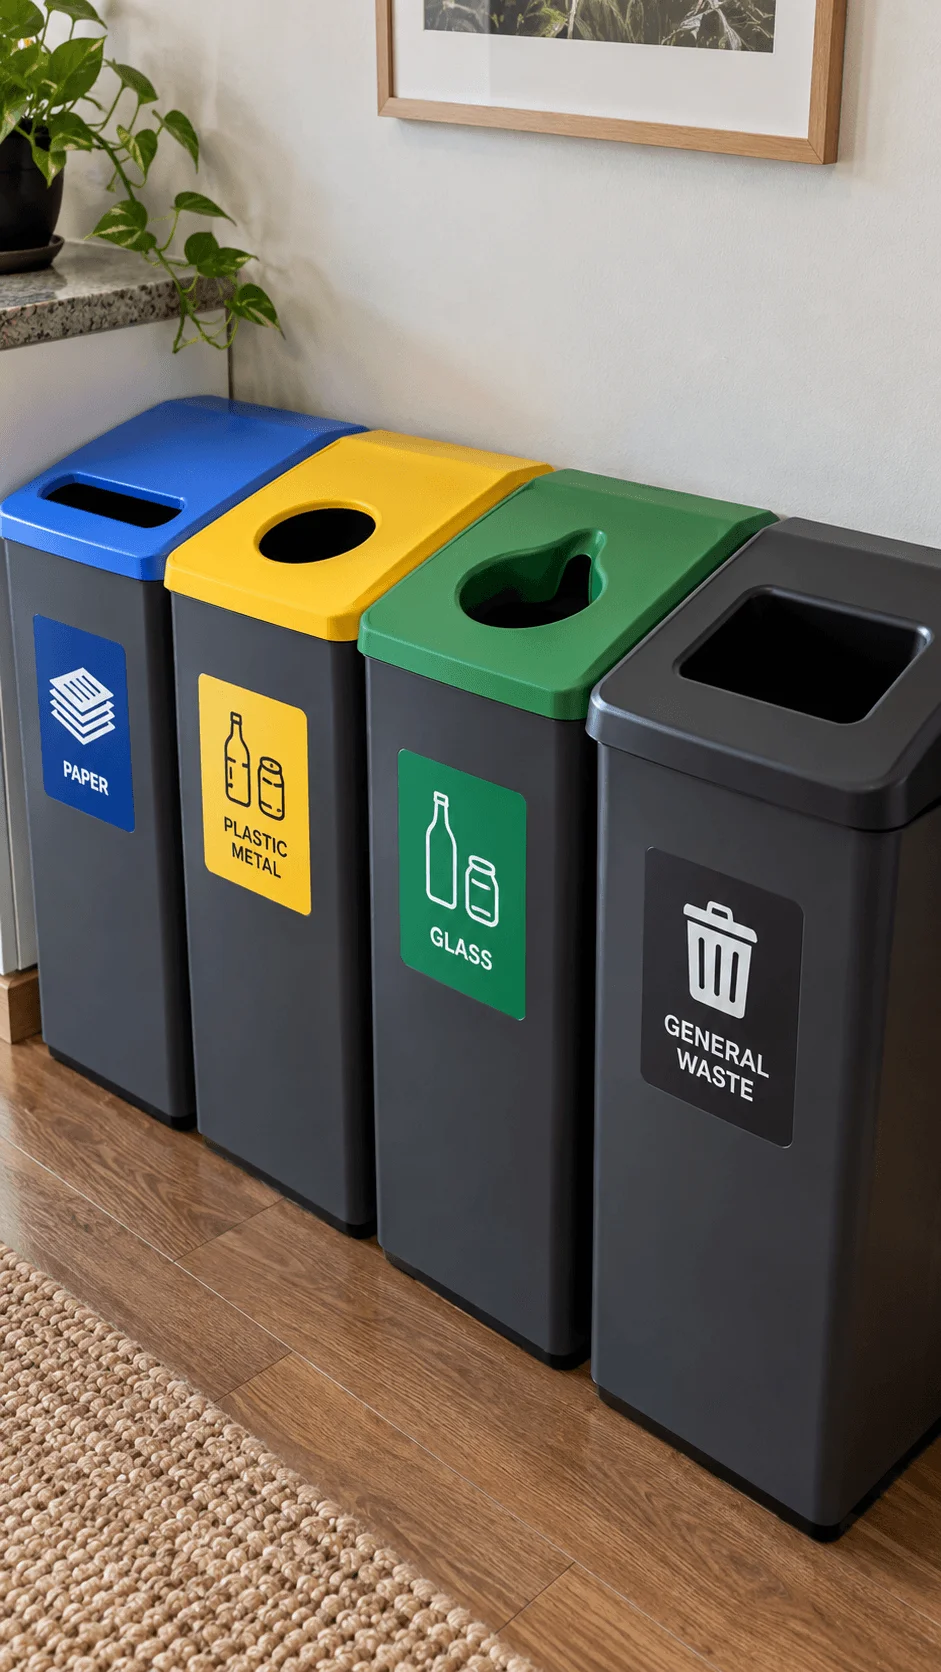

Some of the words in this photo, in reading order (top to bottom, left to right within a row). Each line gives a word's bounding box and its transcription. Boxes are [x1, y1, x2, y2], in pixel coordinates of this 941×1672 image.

[63, 760, 109, 796] PAPER
[224, 817, 288, 858] PLASTIC
[231, 842, 282, 878] METAL
[430, 926, 493, 971] GLASS
[664, 1014, 770, 1079] GENERAL
[676, 1047, 754, 1102] WASTE
